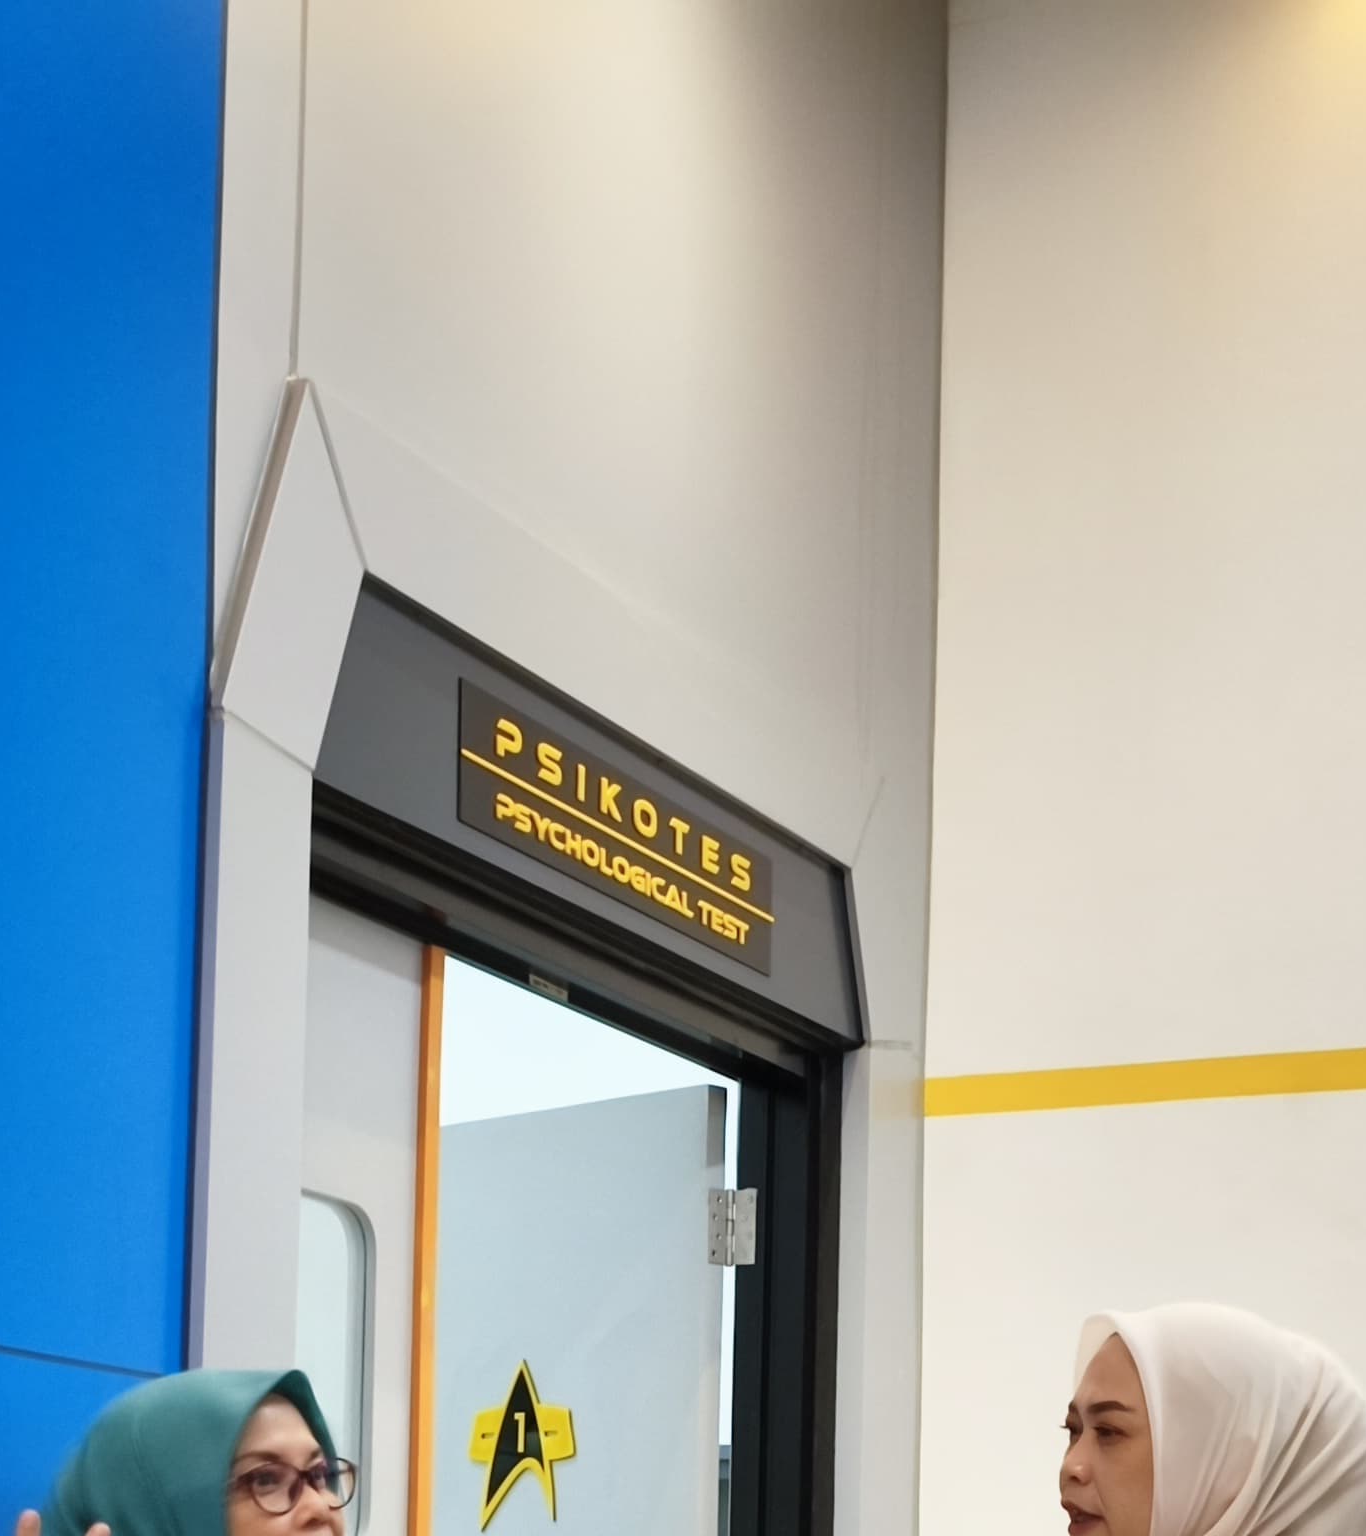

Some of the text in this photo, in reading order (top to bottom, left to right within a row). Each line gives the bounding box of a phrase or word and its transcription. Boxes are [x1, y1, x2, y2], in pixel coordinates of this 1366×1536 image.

[495, 718, 752, 891] PSIKOTES
[495, 793, 750, 945] PSYCHOLOGICAL TEST
[514, 1412, 526, 1453] 1
